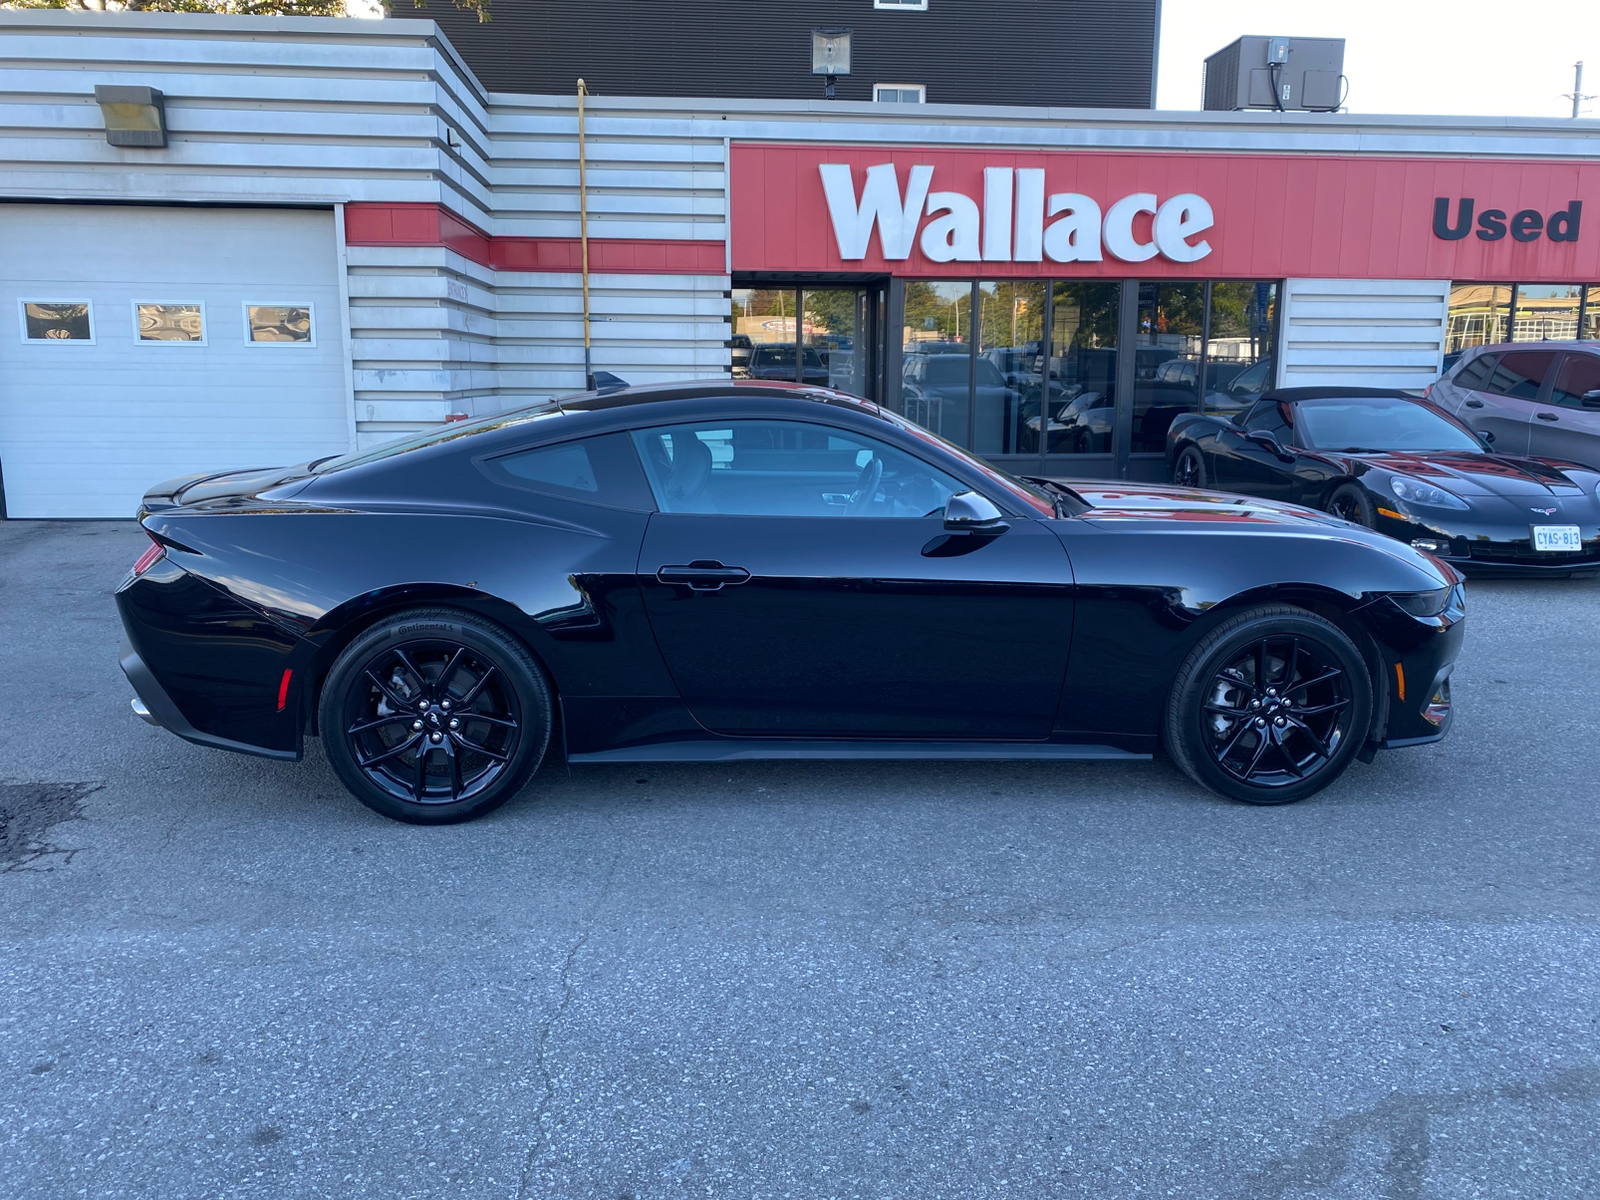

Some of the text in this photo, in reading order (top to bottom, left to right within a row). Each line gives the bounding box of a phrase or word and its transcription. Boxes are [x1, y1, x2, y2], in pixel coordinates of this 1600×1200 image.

[818, 163, 1214, 263] Wallace
[1433, 197, 1583, 242] Used
[398, 623, 447, 635] Continental
